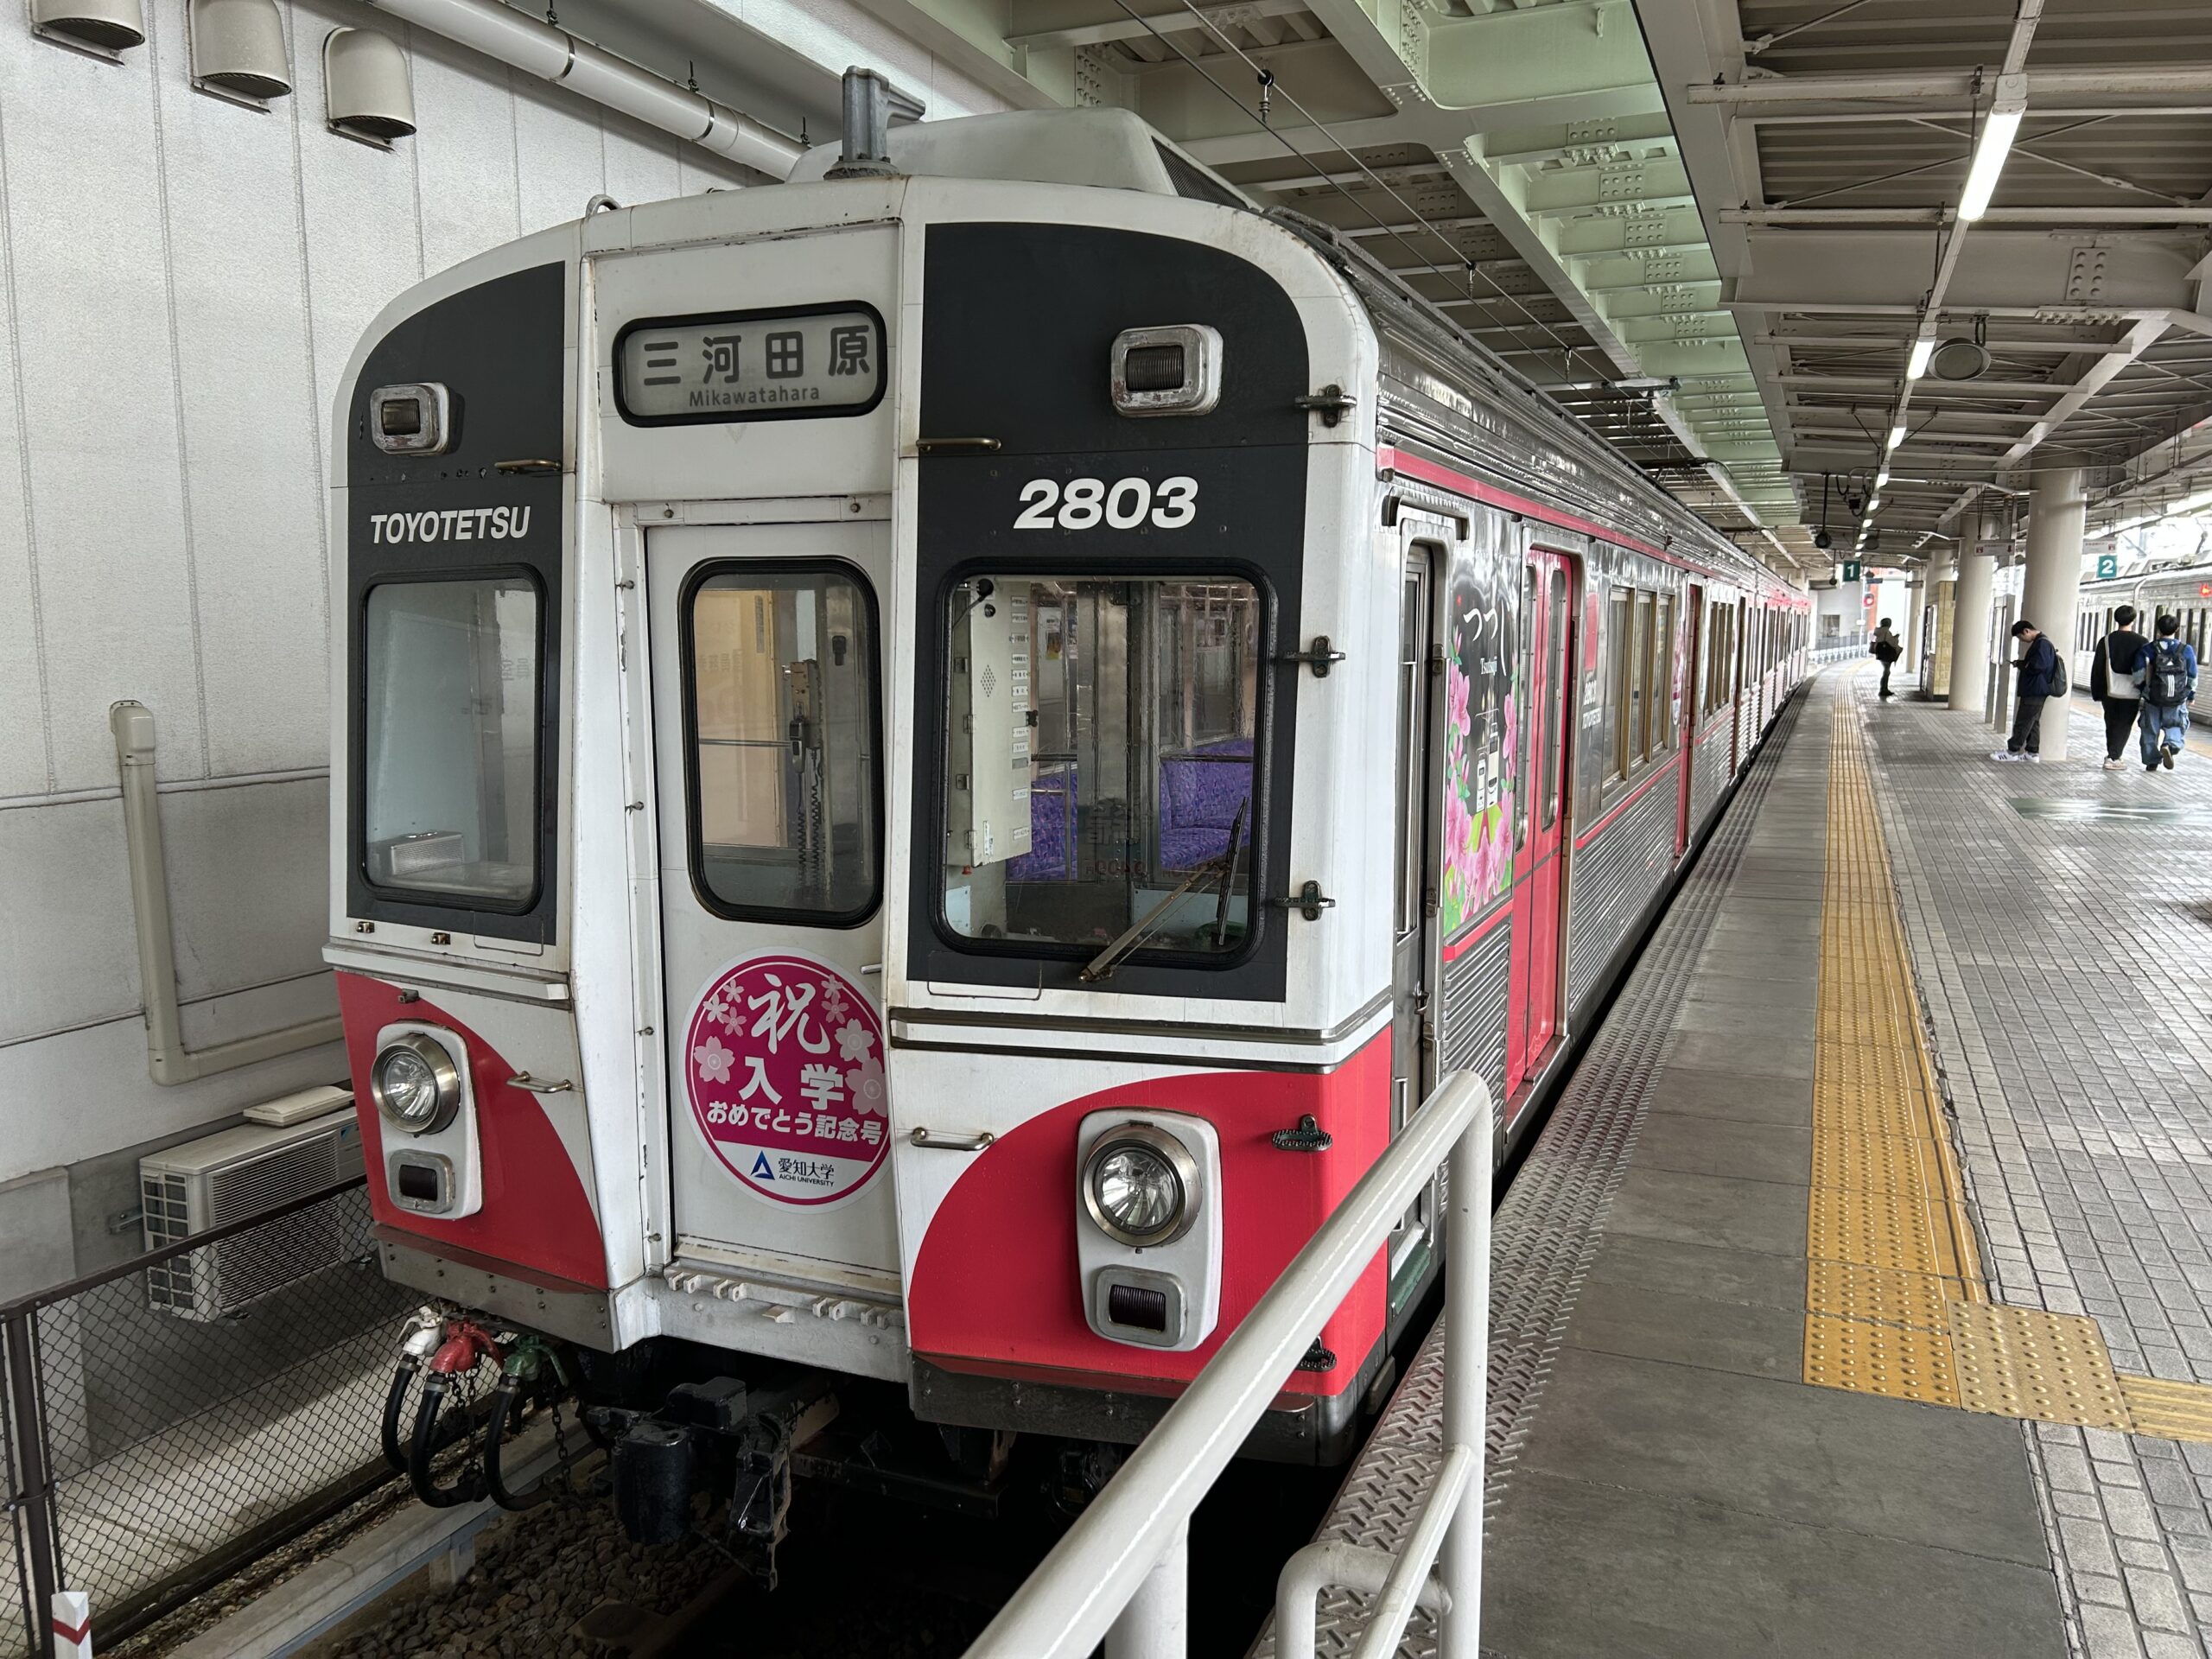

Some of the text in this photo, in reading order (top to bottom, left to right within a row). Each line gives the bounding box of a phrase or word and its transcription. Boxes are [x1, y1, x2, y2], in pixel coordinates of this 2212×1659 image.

[643, 325, 870, 386] 三河田原
[689, 385, 821, 408] Mikawatahara
[1013, 475, 1200, 530] 2803
[370, 505, 531, 544] TOYOTETSU
[1847, 564, 1855, 578] 1
[2101, 559, 2114, 575] 2
[747, 973, 831, 1054] 祝
[738, 1055, 845, 1111] 入学
[706, 1100, 882, 1146] おめでとう記念号
[778, 1158, 835, 1180] 愛知大学
[797, 1176, 835, 1187] UNIVERSITY
